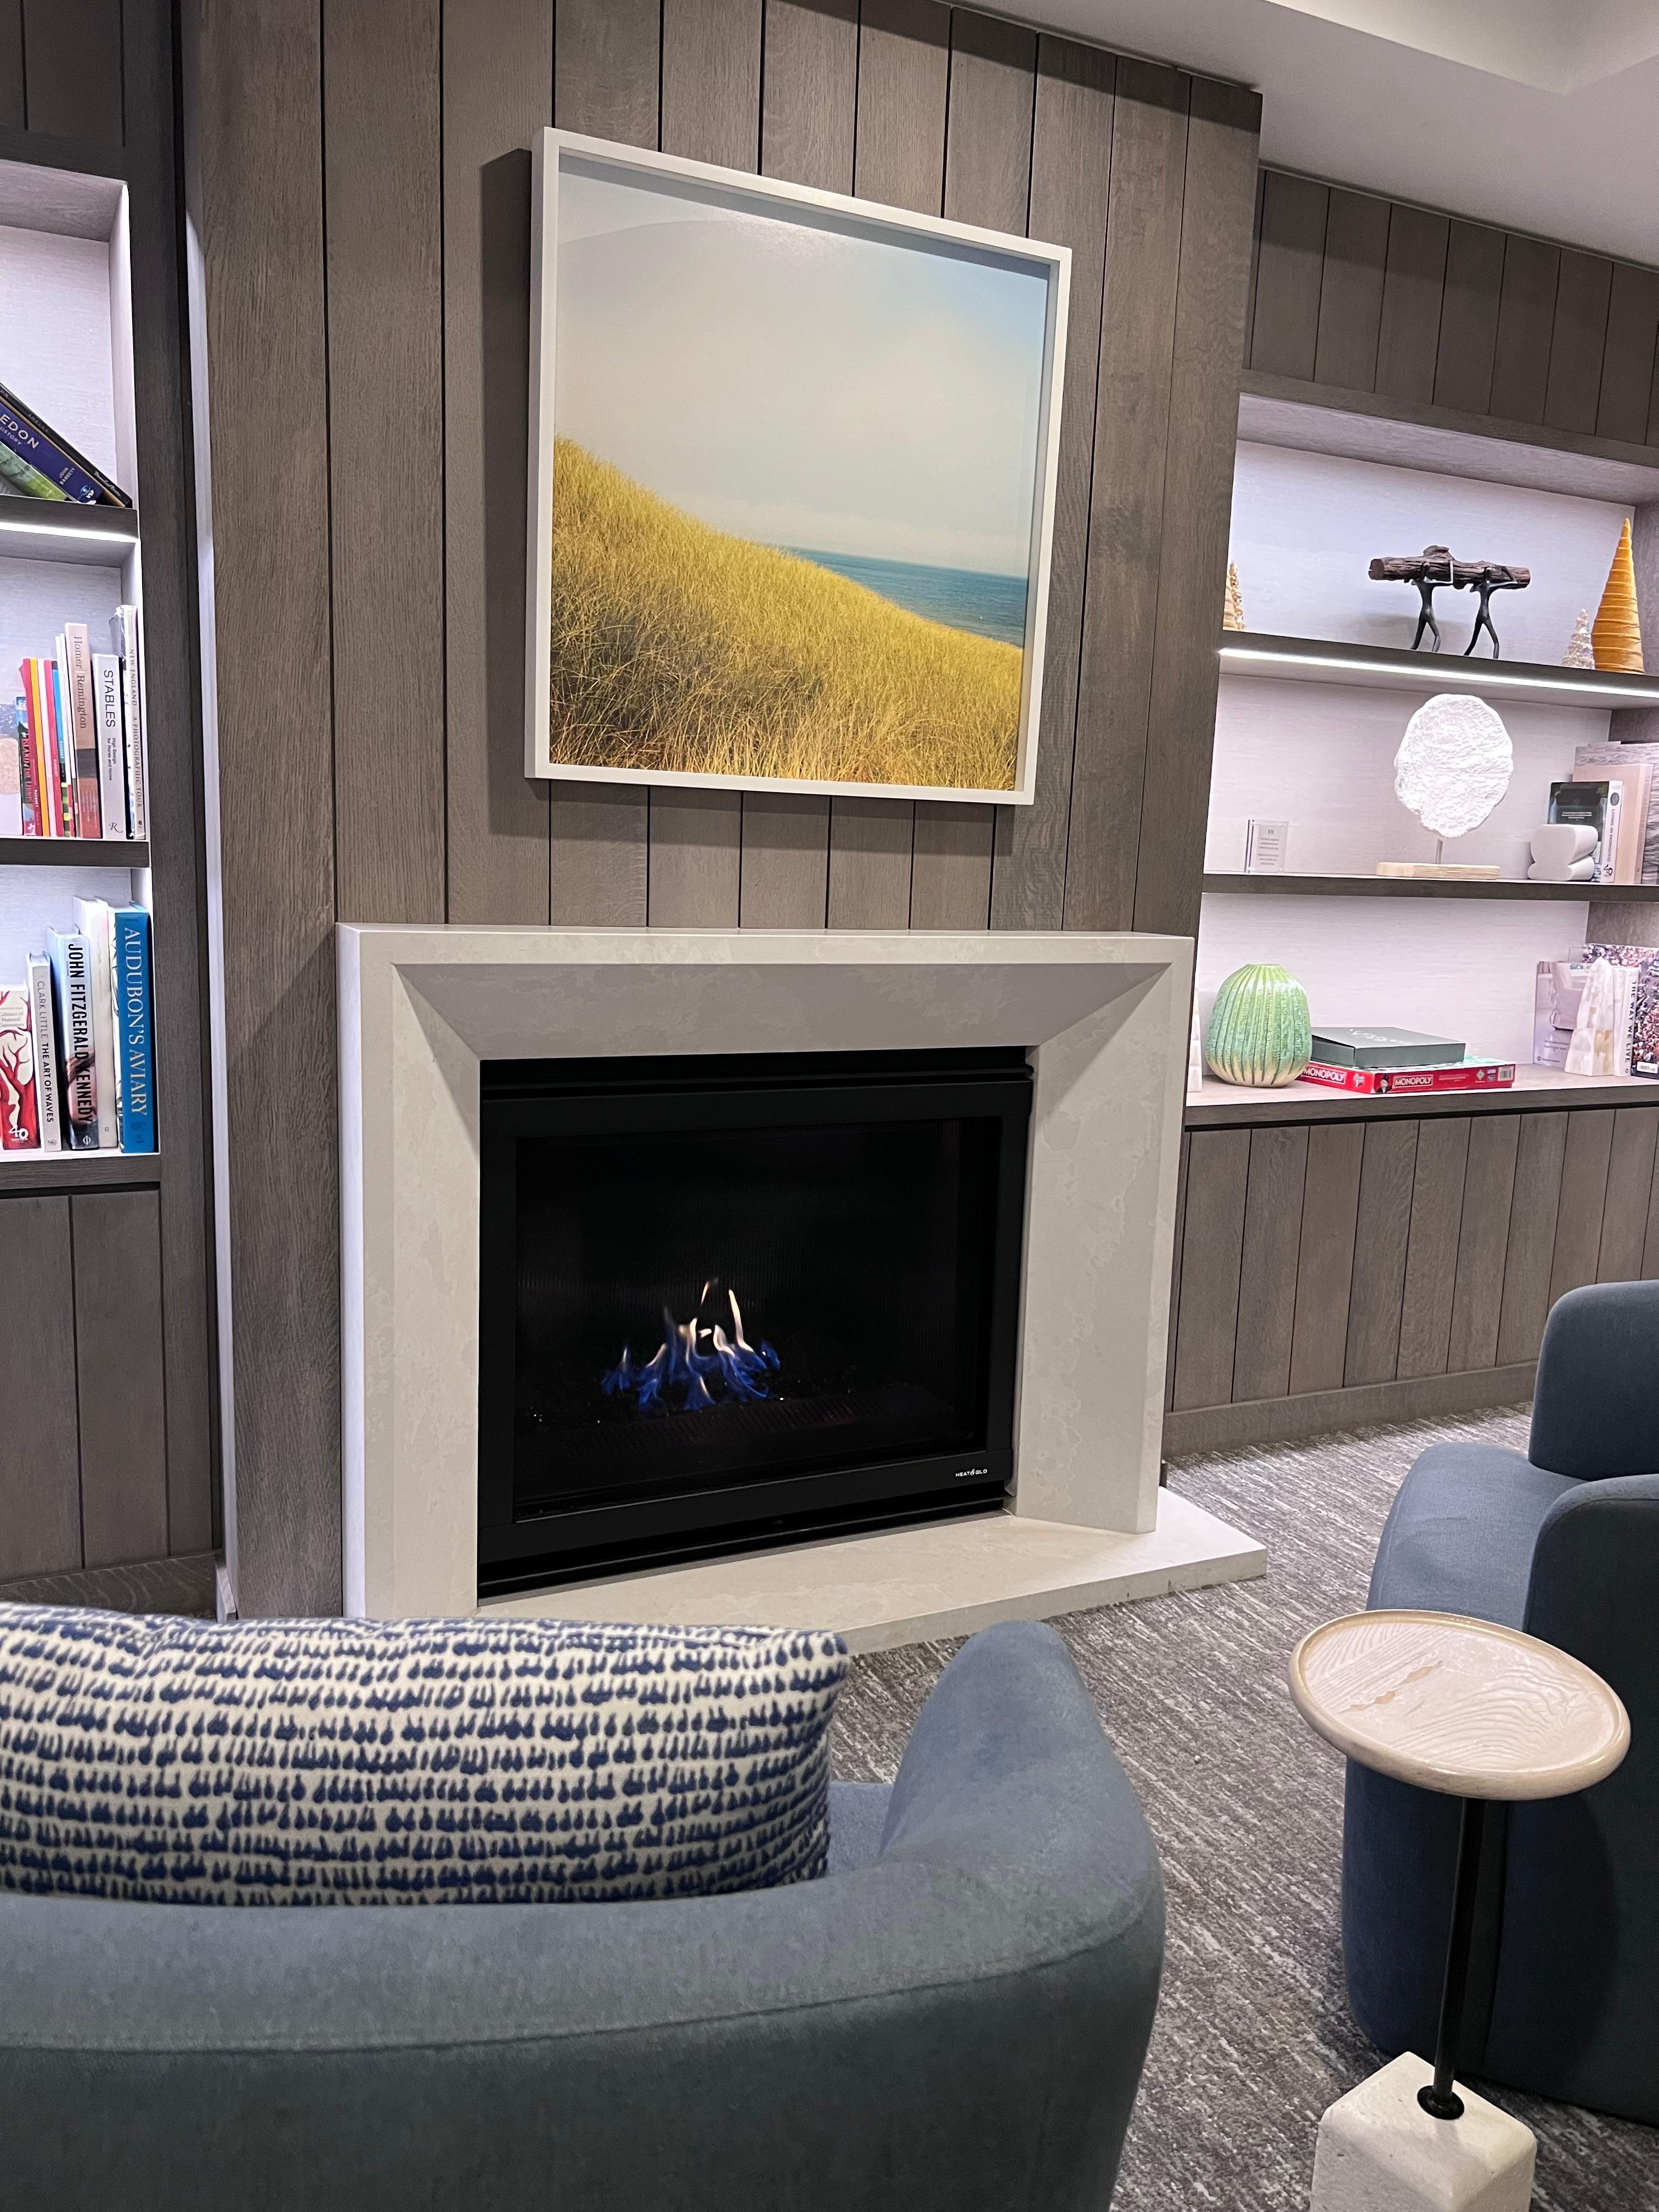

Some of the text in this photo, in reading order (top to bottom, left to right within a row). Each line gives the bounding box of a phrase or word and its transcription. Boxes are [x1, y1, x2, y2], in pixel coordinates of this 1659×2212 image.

[77, 675, 88, 729] Remington
[104, 670, 116, 727] STABLES
[133, 724, 141, 785] PHOTOGRAPHIC
[109, 822, 123, 833] R
[37, 981, 46, 1008] CLARK
[125, 927, 145, 1045] AUDUBON'S
[39, 1012, 48, 1038] LITTLE
[68, 944, 93, 1122] JOHN FITZGERALD KENNEDY
[1627, 1025, 1633, 1039] WE
[44, 1080, 52, 1094] OF
[129, 1049, 147, 1115] AVIARY
[1303, 1067, 1345, 1082] MONOPOLY
[1395, 1076, 1432, 1086] MONOPOLY
[46, 1094, 54, 1122] WAVES
